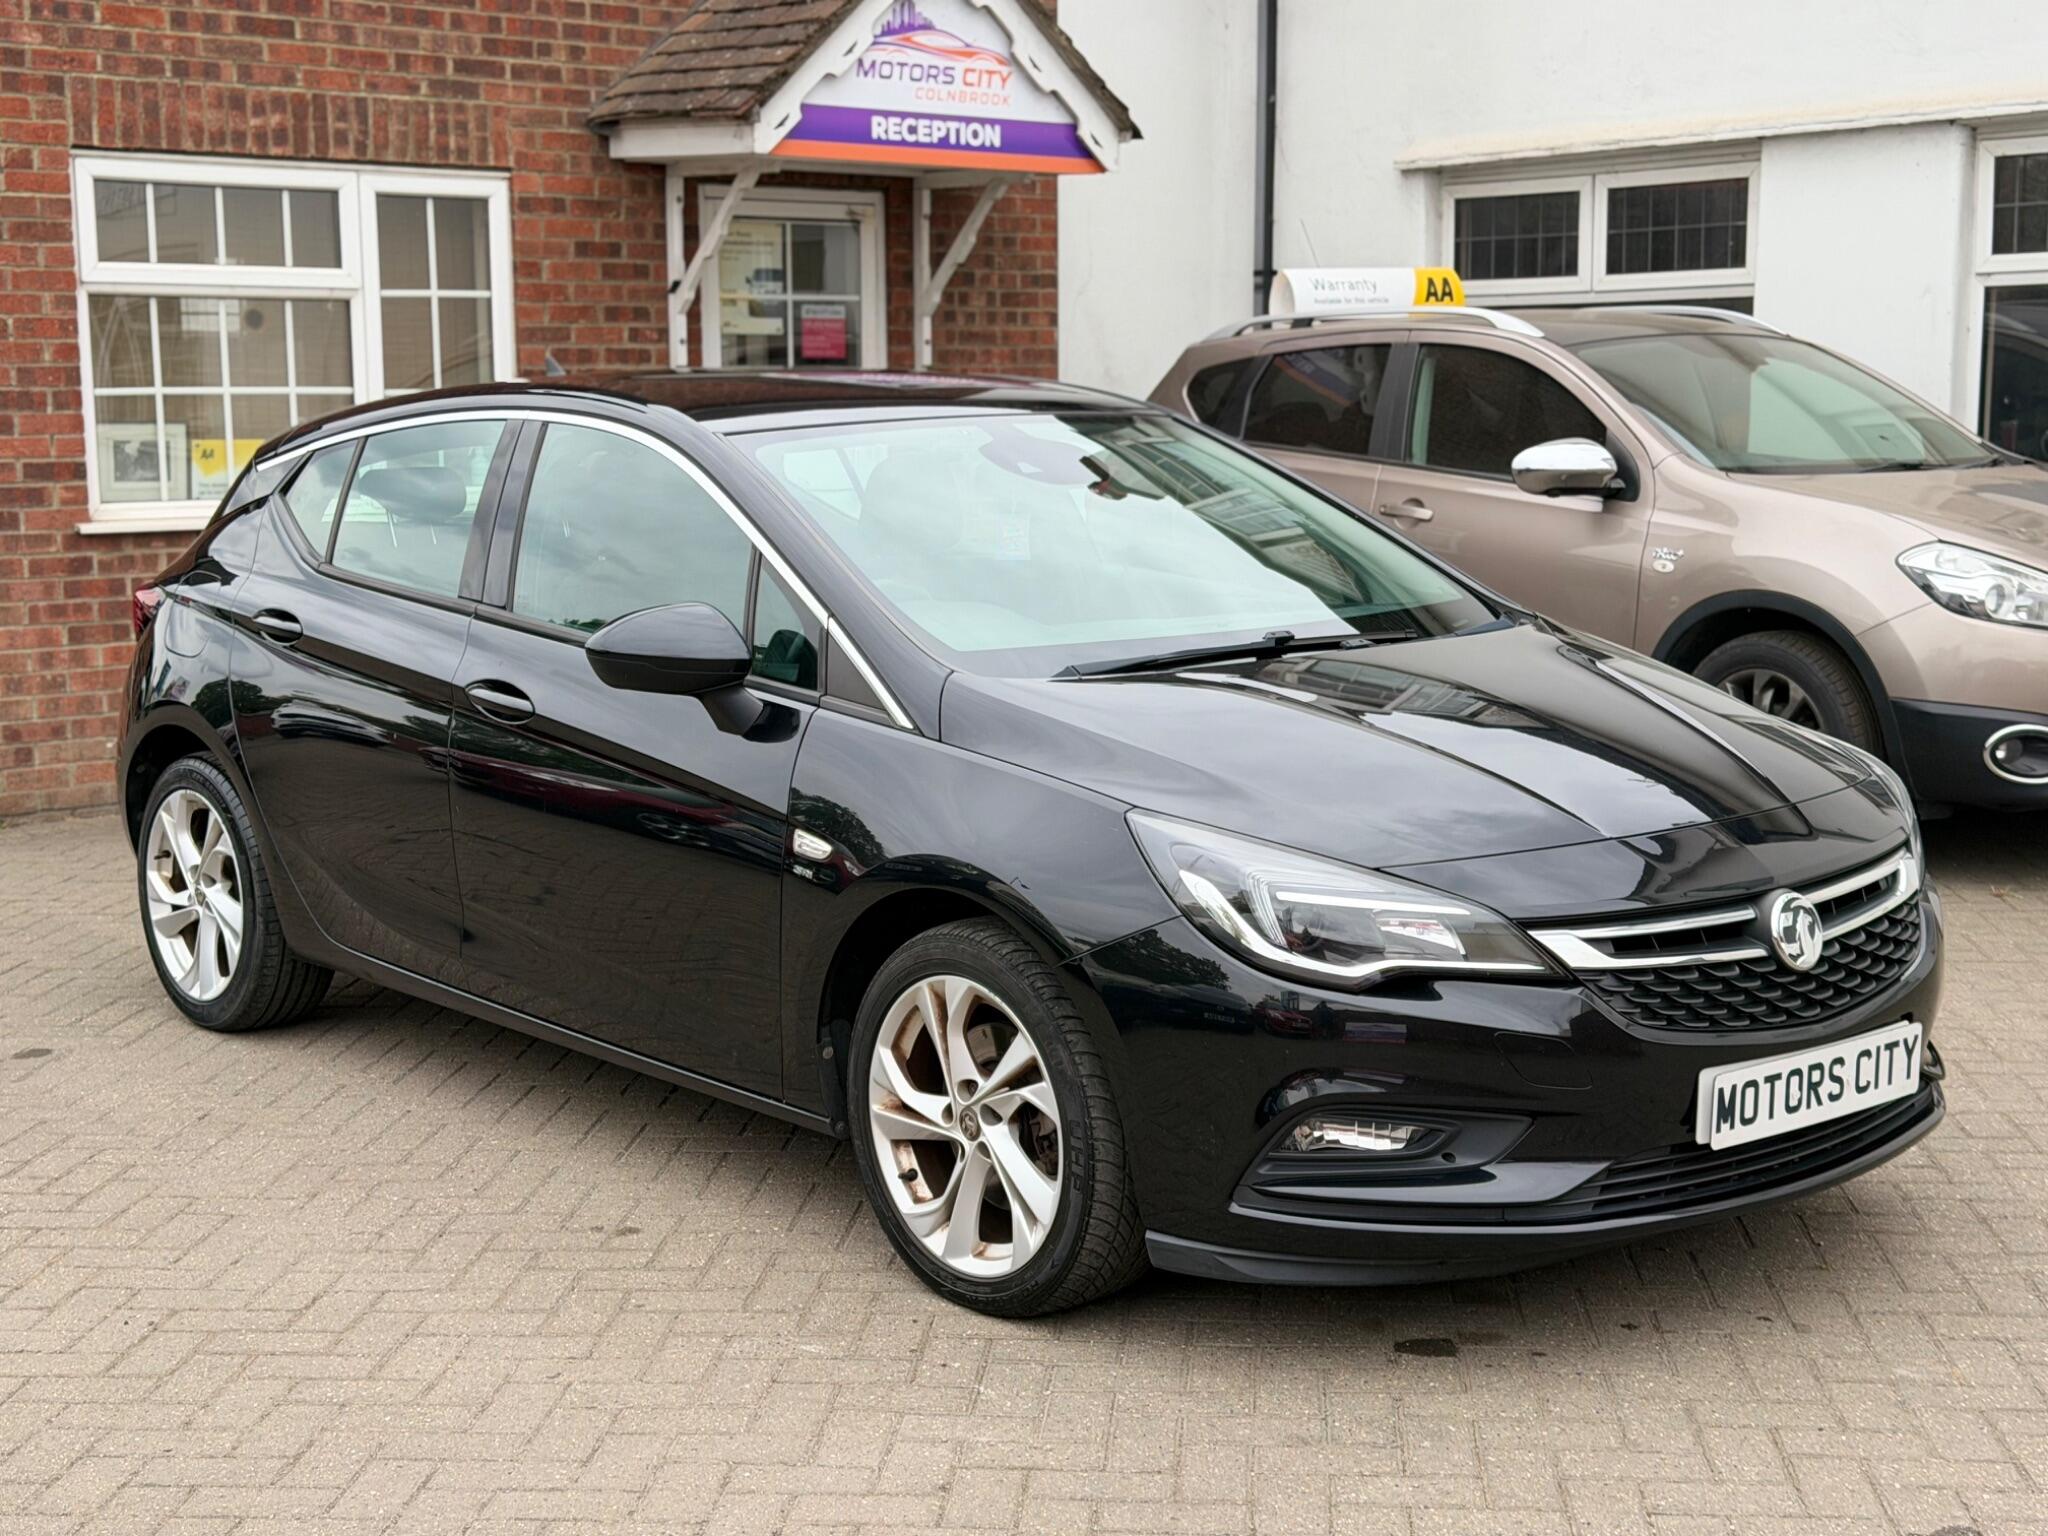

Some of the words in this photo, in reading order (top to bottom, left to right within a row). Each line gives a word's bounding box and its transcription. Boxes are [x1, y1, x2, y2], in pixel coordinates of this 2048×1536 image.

[856, 59, 956, 86] MOTORS
[962, 68, 1013, 89] CITY
[914, 87, 1011, 106] COLNBROOK
[870, 115, 1002, 148] RECEPTION
[1309, 277, 1377, 295] Warranty
[1425, 277, 1455, 302] AA
[1716, 1056, 1846, 1135] MOTORS
[1855, 1034, 1919, 1095] CITY
